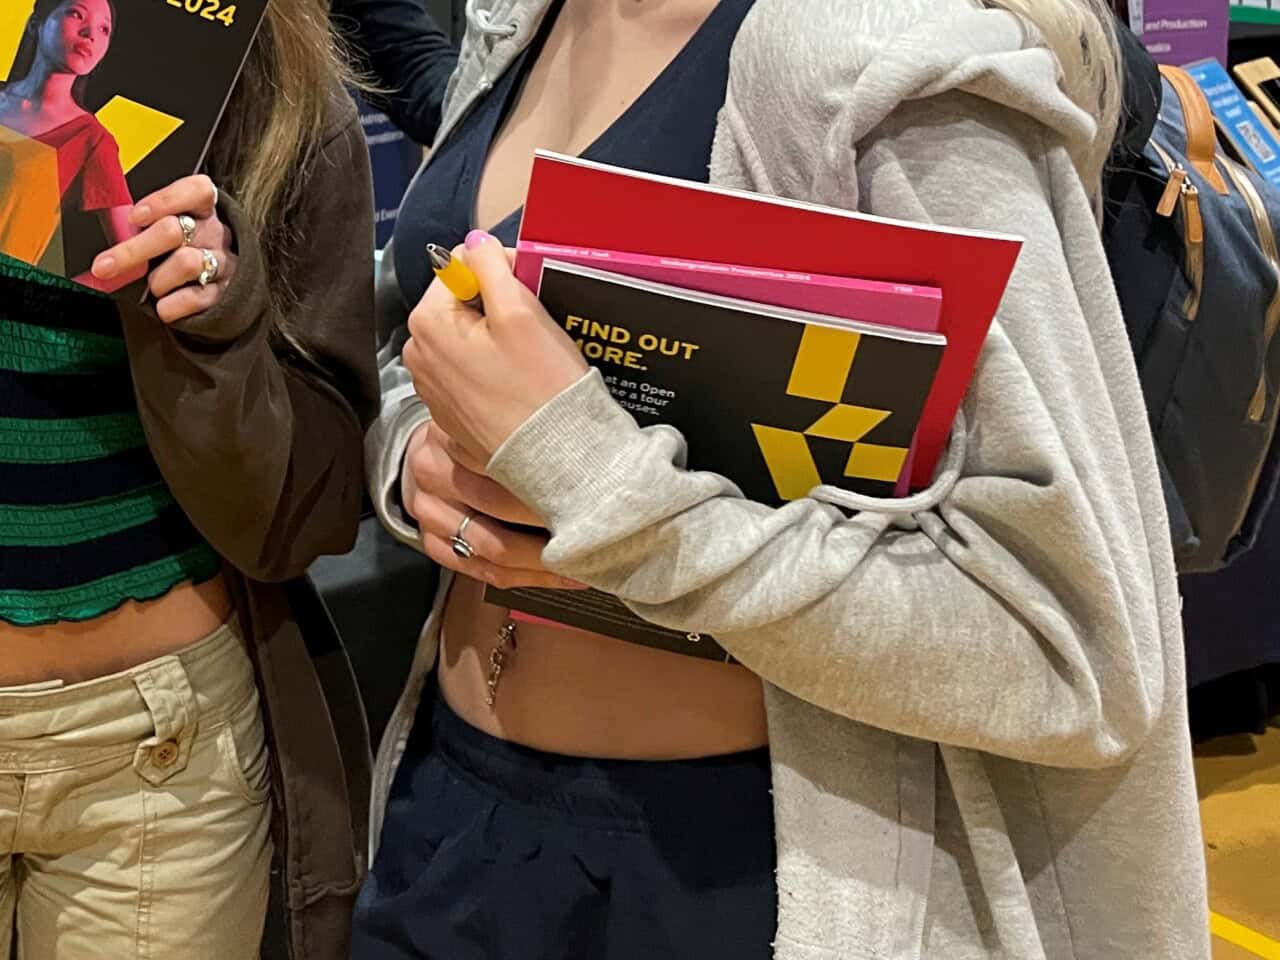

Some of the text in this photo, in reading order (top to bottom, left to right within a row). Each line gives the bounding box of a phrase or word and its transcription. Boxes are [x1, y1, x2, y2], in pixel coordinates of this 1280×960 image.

[1160, 18, 1208, 30] Production
[565, 315, 700, 360] FIND OUT
[575, 338, 648, 372] ORE.
[620, 379, 638, 390] an
[639, 382, 676, 400] Open
[629, 392, 638, 400] a
[640, 391, 669, 407] tour
